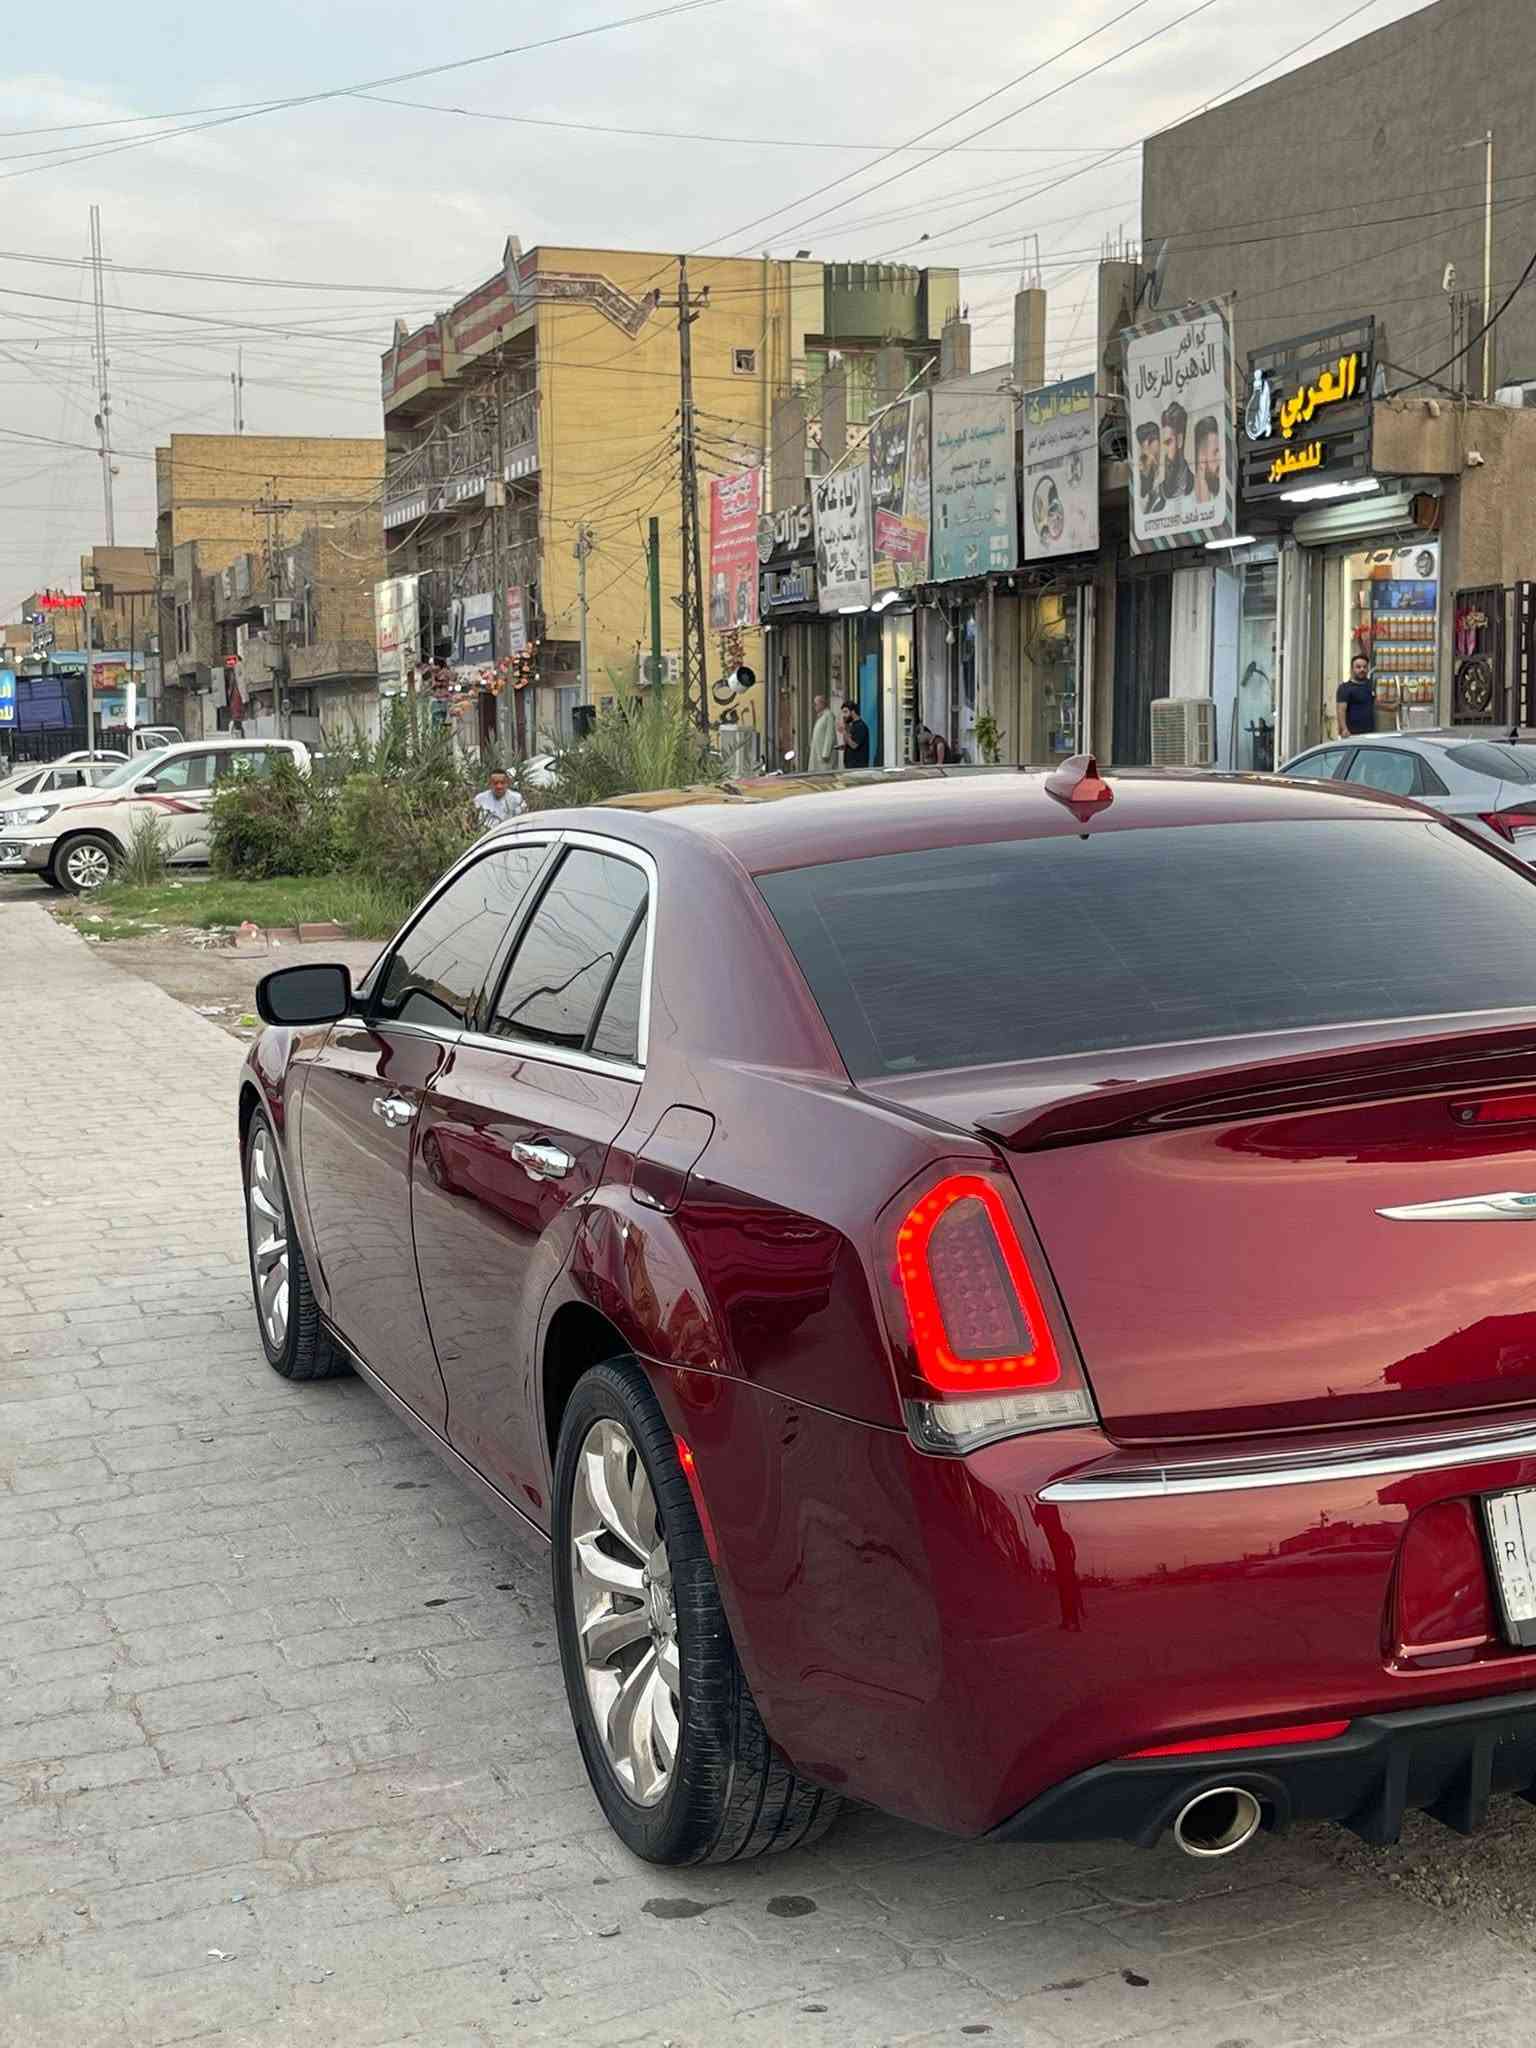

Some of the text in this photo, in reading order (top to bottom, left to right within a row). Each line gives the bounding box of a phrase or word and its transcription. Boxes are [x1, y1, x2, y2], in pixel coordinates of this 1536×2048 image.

[1175, 322, 1206, 360] كوافير
[1135, 343, 1216, 399] الذهبي للرجال
[1280, 353, 1357, 438] العربي
[1268, 441, 1321, 482] للعطور
[773, 503, 811, 551] كرزات
